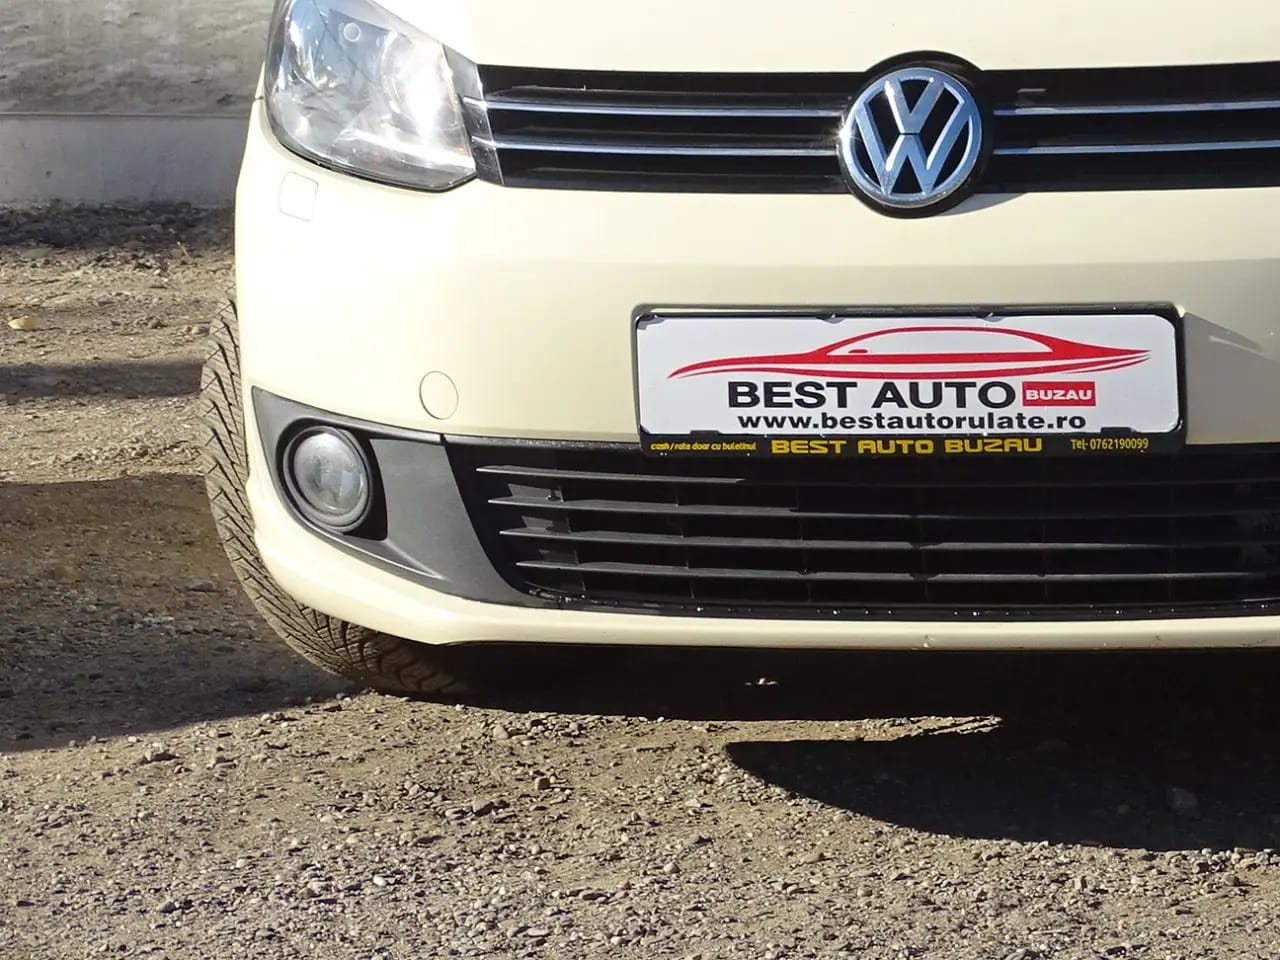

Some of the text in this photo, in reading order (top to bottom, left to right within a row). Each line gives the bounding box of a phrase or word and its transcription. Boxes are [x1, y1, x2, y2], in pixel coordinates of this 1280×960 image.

[727, 380, 1093, 409] BEST AUTO BUZAU
[737, 411, 1086, 430] www.bestautorulate.ro
[771, 438, 1043, 455] BEST AUTO BUZAU
[1090, 437, 1149, 450] 0762190099
